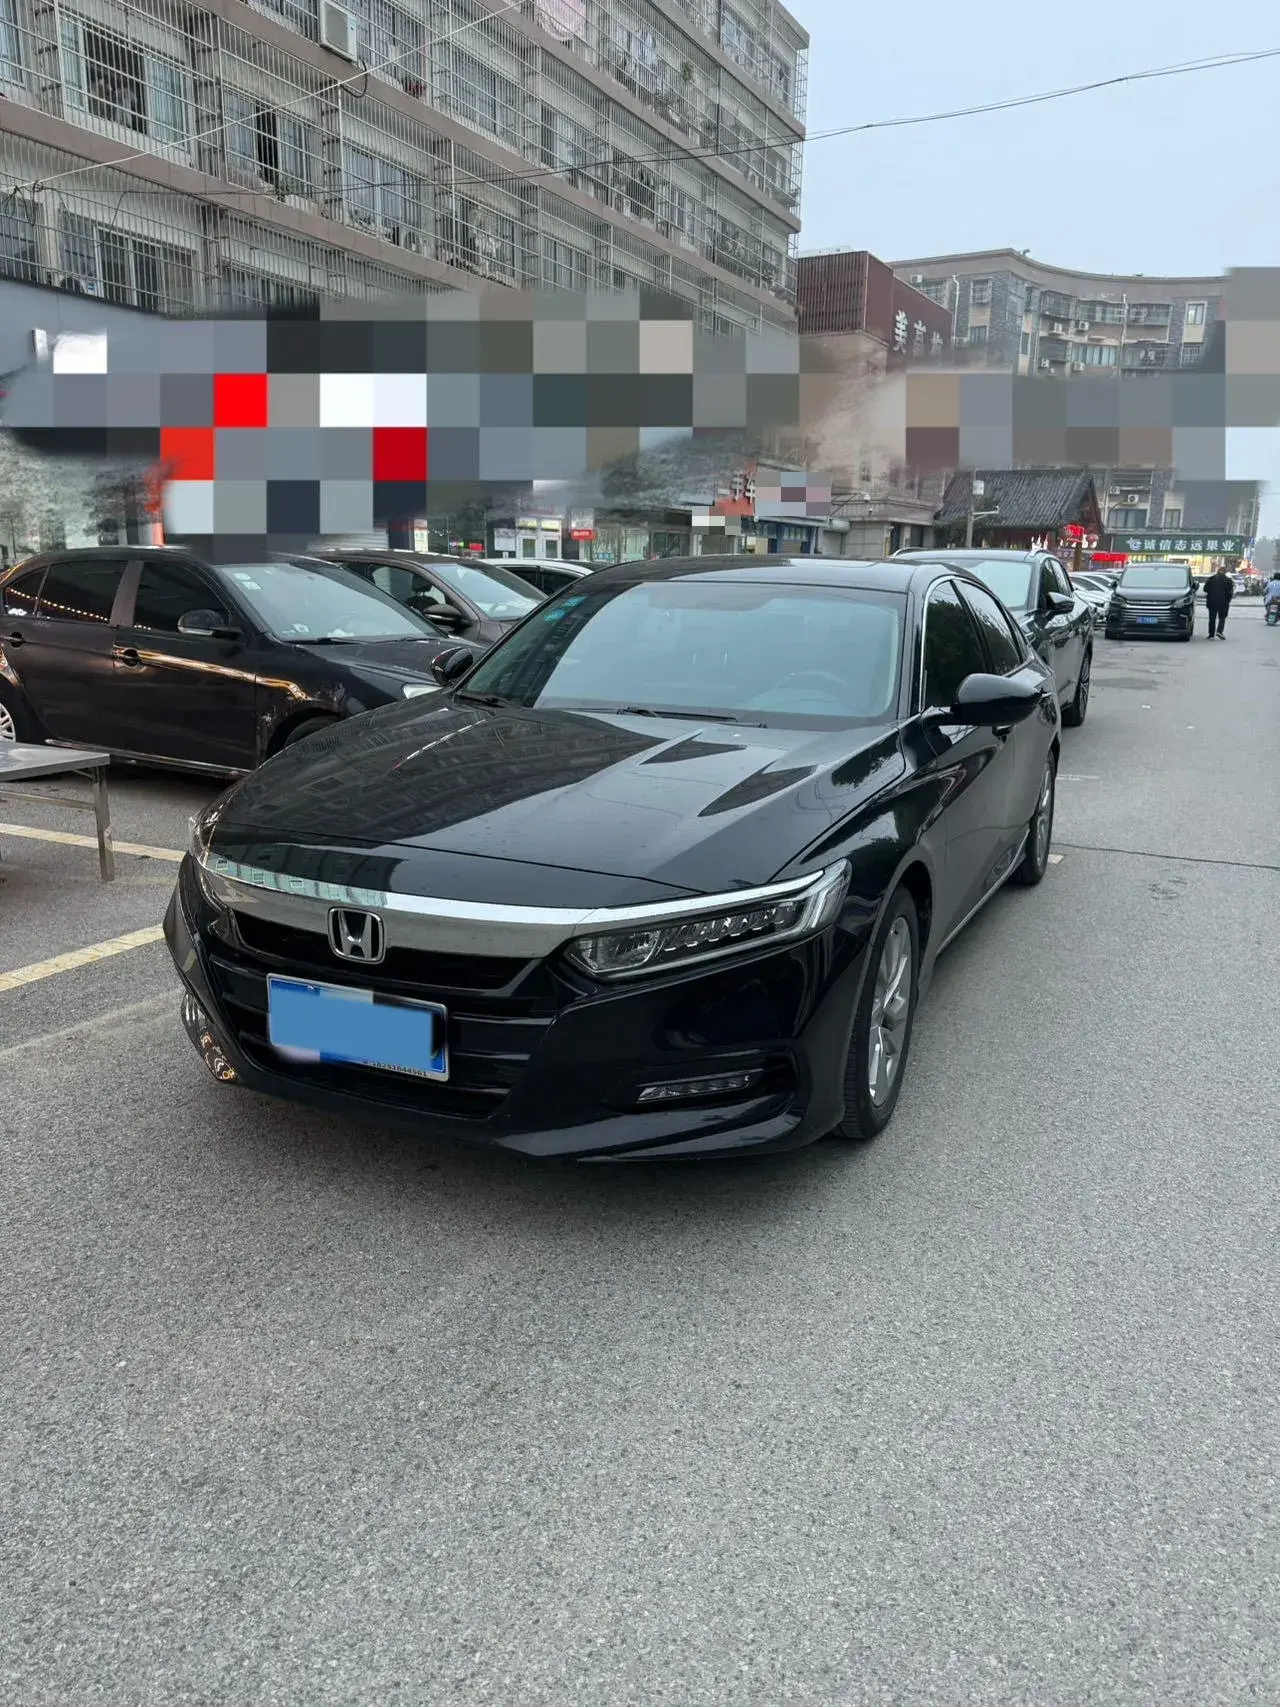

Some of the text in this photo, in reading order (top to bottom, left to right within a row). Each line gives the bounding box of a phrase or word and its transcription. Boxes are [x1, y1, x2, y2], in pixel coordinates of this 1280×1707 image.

[1143, 539, 1235, 552] 诚信志远果业
